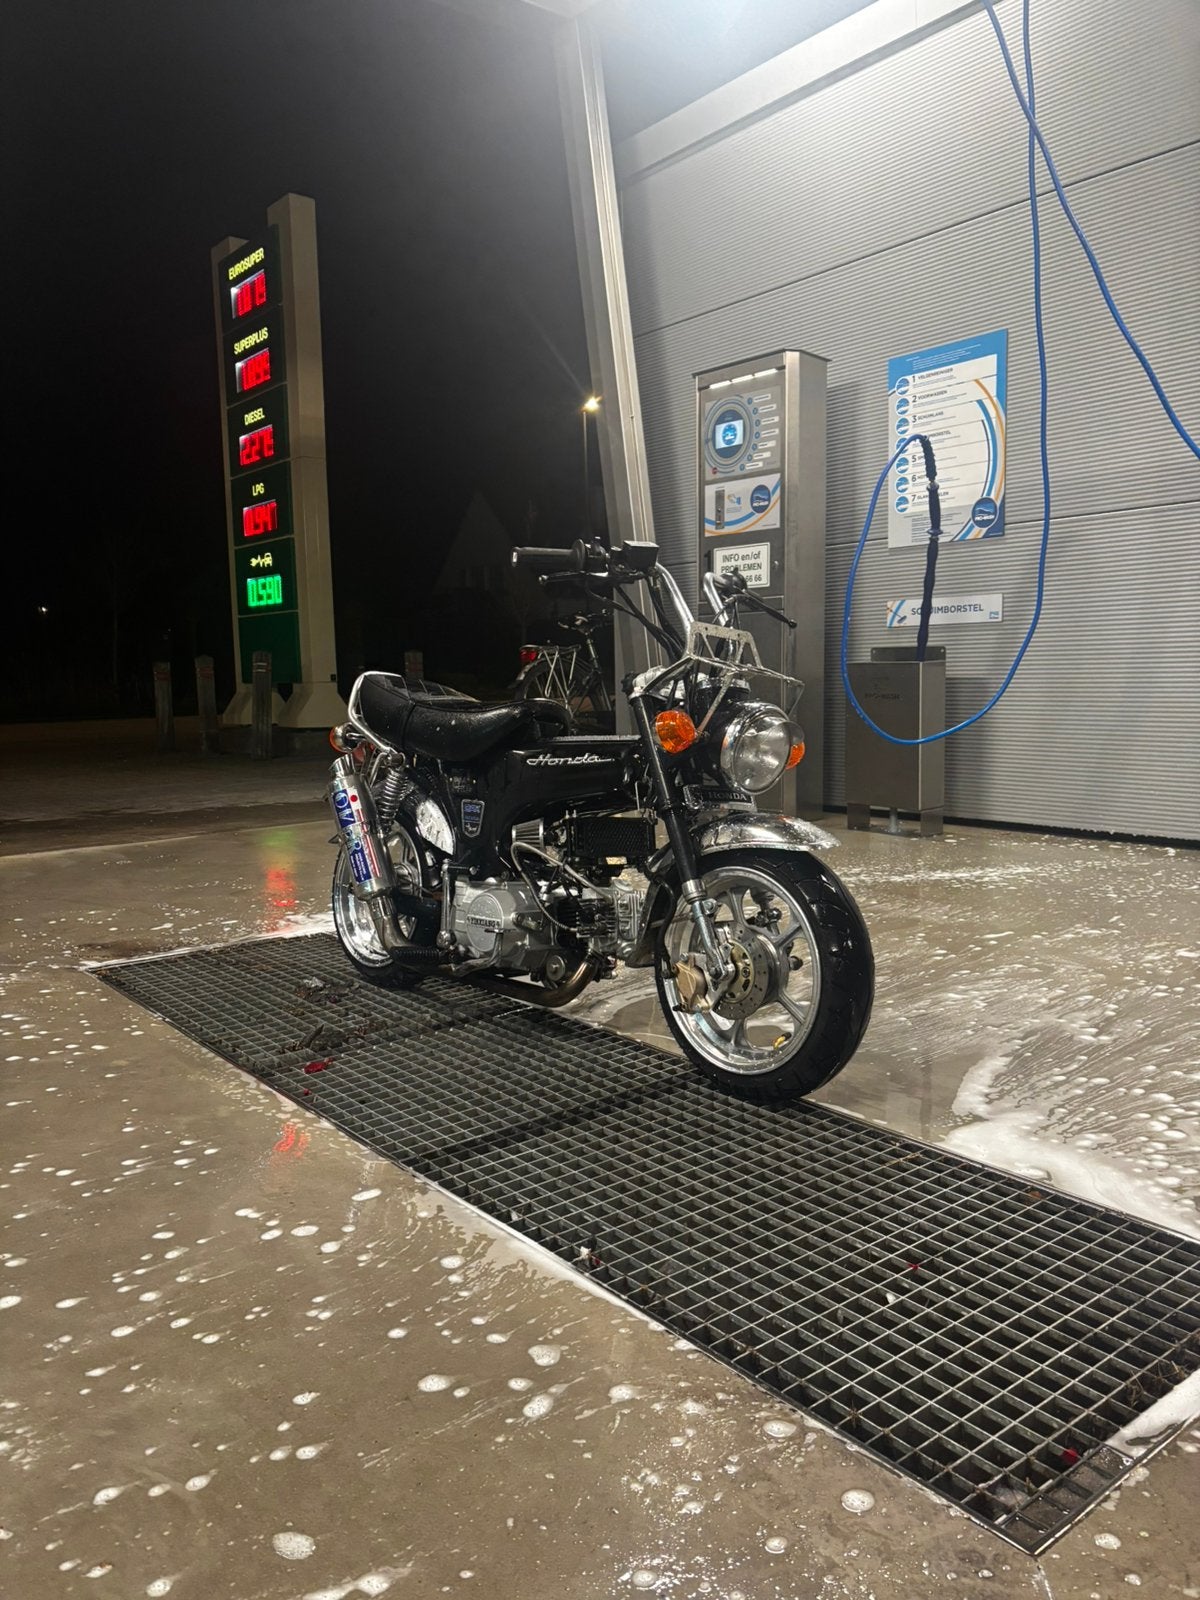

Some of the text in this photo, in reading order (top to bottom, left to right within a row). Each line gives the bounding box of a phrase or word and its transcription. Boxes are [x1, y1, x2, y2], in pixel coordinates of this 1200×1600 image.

[228, 247, 265, 280] EUROSUPER
[233, 327, 269, 354] SUPERPLUS
[911, 395, 917, 403] 2
[244, 407, 266, 426] DIESEL
[911, 415, 917, 423] 3
[911, 454, 917, 462] 5
[252, 483, 265, 496] LPG
[911, 494, 917, 502] 7
[722, 550, 761, 563] INFO en/of
[754, 574, 762, 582] 66
[526, 752, 615, 766] Honda
[708, 790, 748, 801] HONDA
